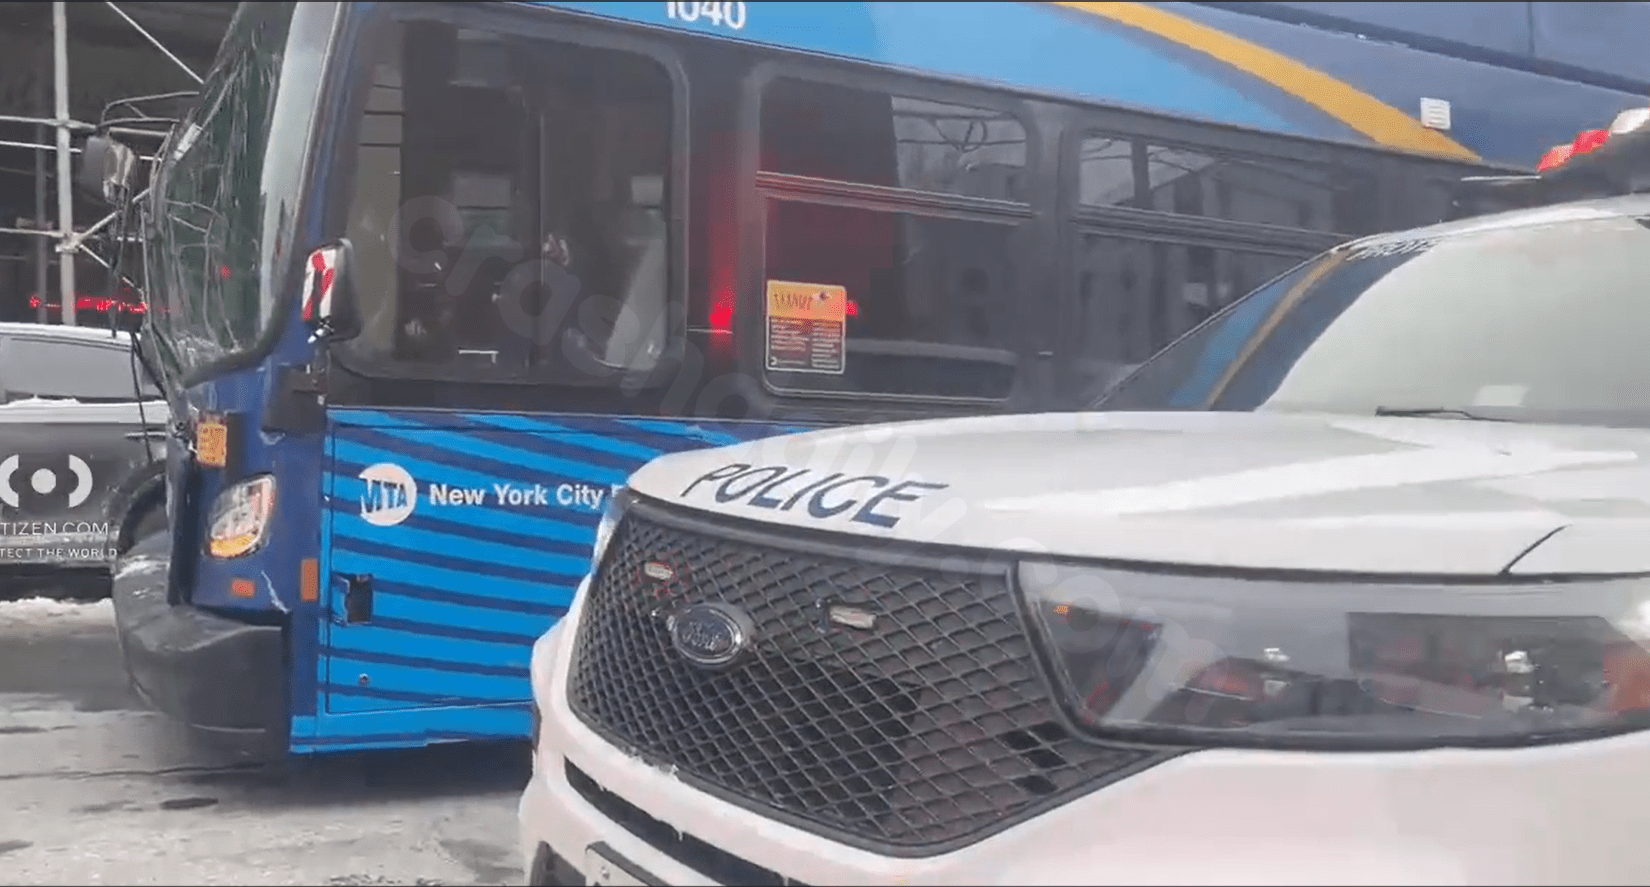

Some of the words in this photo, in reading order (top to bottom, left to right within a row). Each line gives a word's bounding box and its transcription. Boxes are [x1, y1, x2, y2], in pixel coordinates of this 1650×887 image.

[429, 483, 485, 506] New
[492, 483, 549, 507] York
[556, 483, 604, 511] City
[679, 463, 950, 530] POLICE
